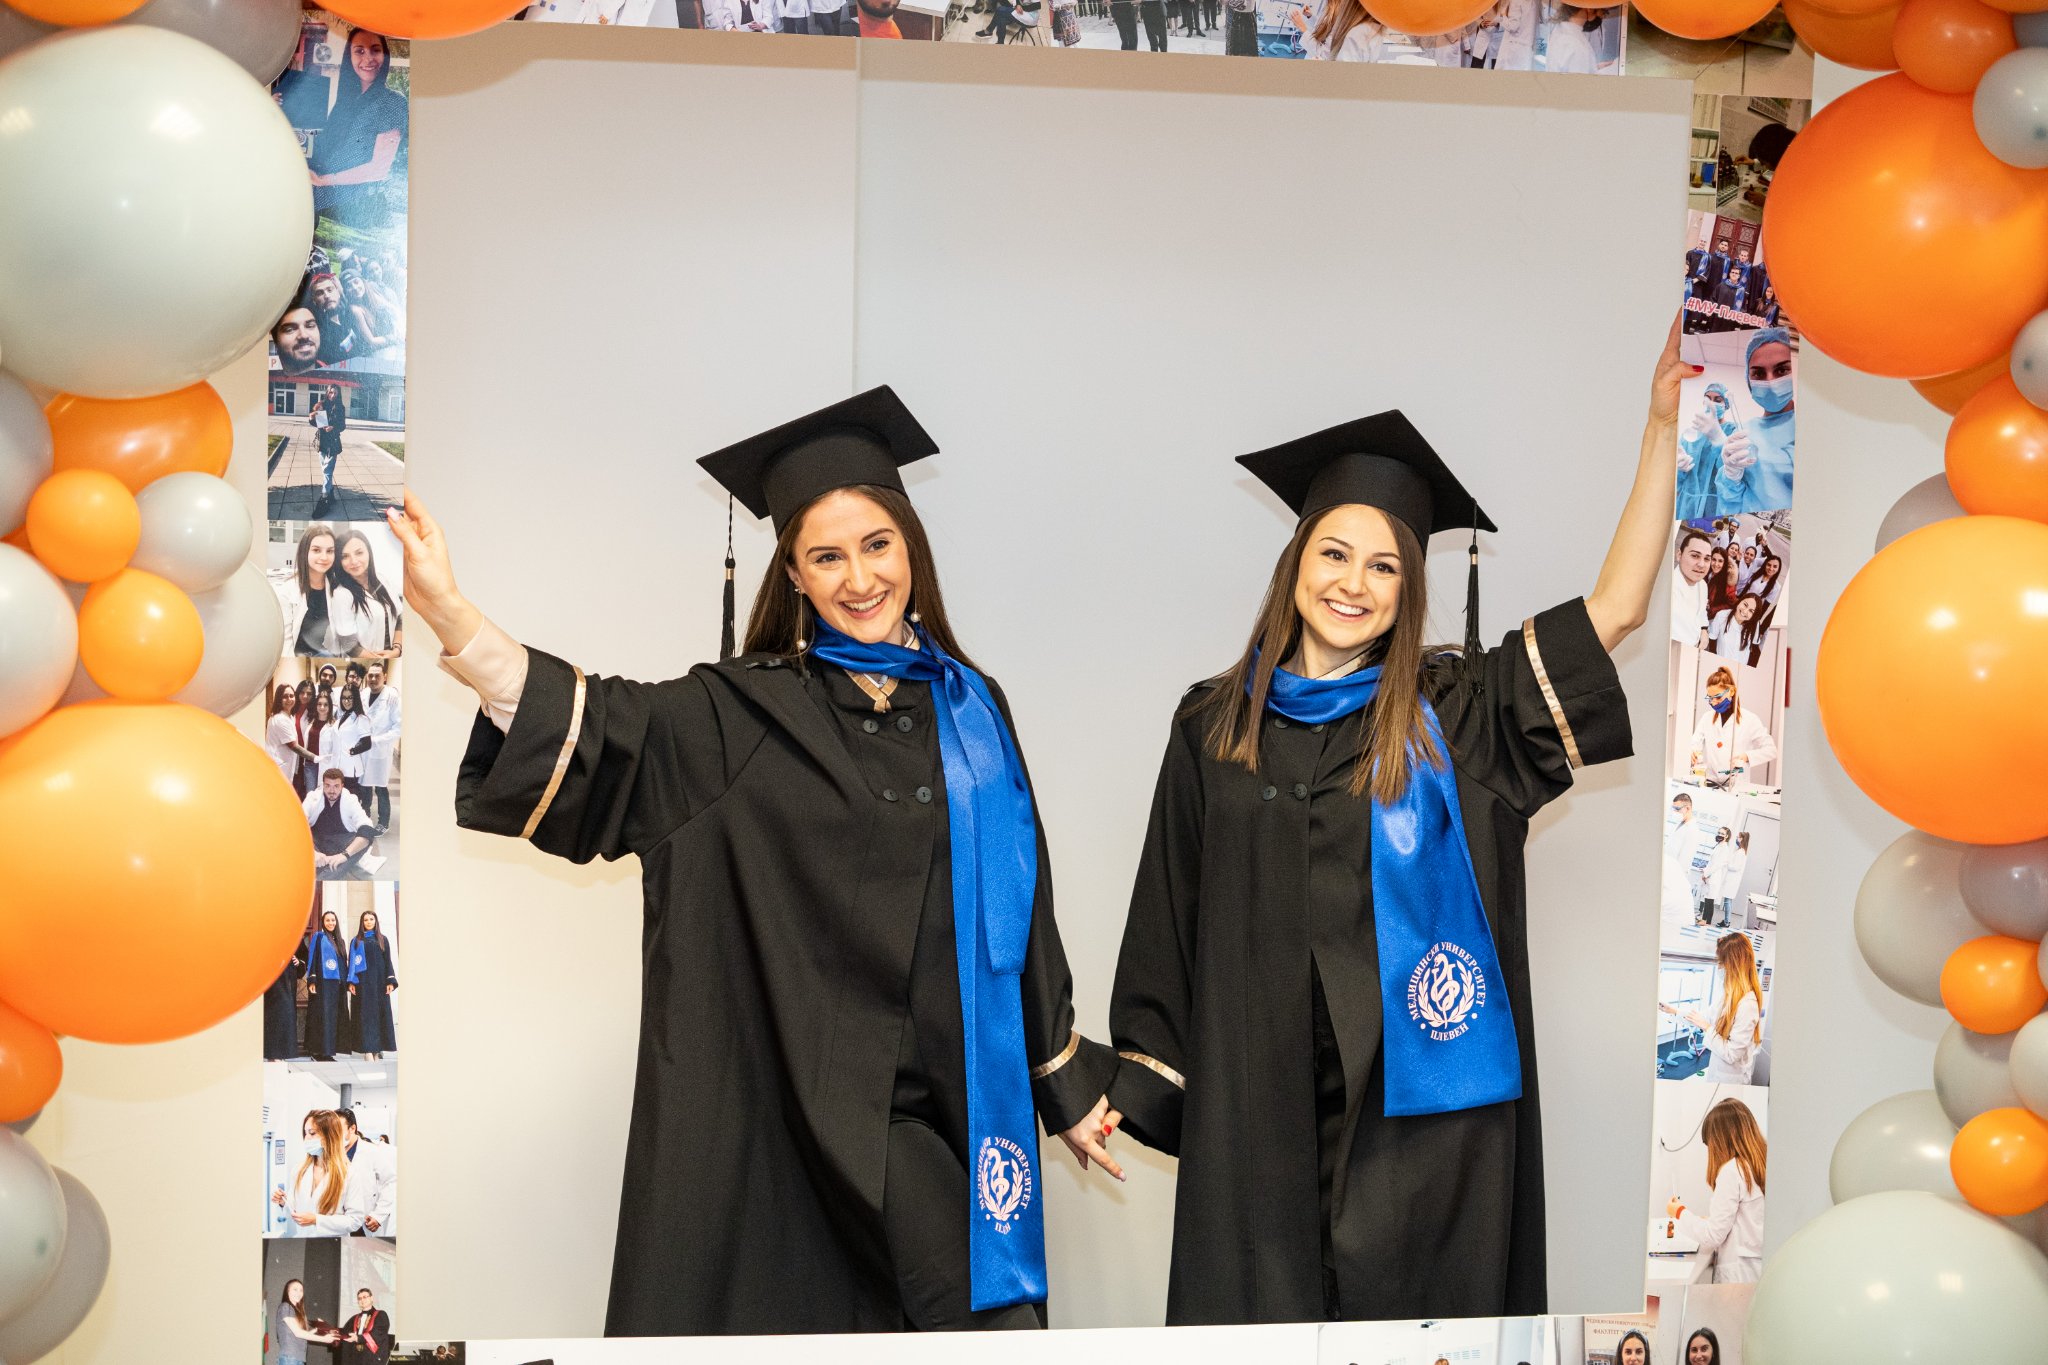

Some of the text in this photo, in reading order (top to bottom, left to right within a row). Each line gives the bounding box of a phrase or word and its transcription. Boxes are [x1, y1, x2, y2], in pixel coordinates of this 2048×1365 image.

[1687, 297, 1767, 329] #МУ-Плевен
[1441, 941, 1486, 1008] УНИВЕРСИТЕТ
[1430, 1022, 1469, 1042] ПЛЕВЕН
[994, 1136, 1032, 1210] УНИВЕРСИТЕТ
